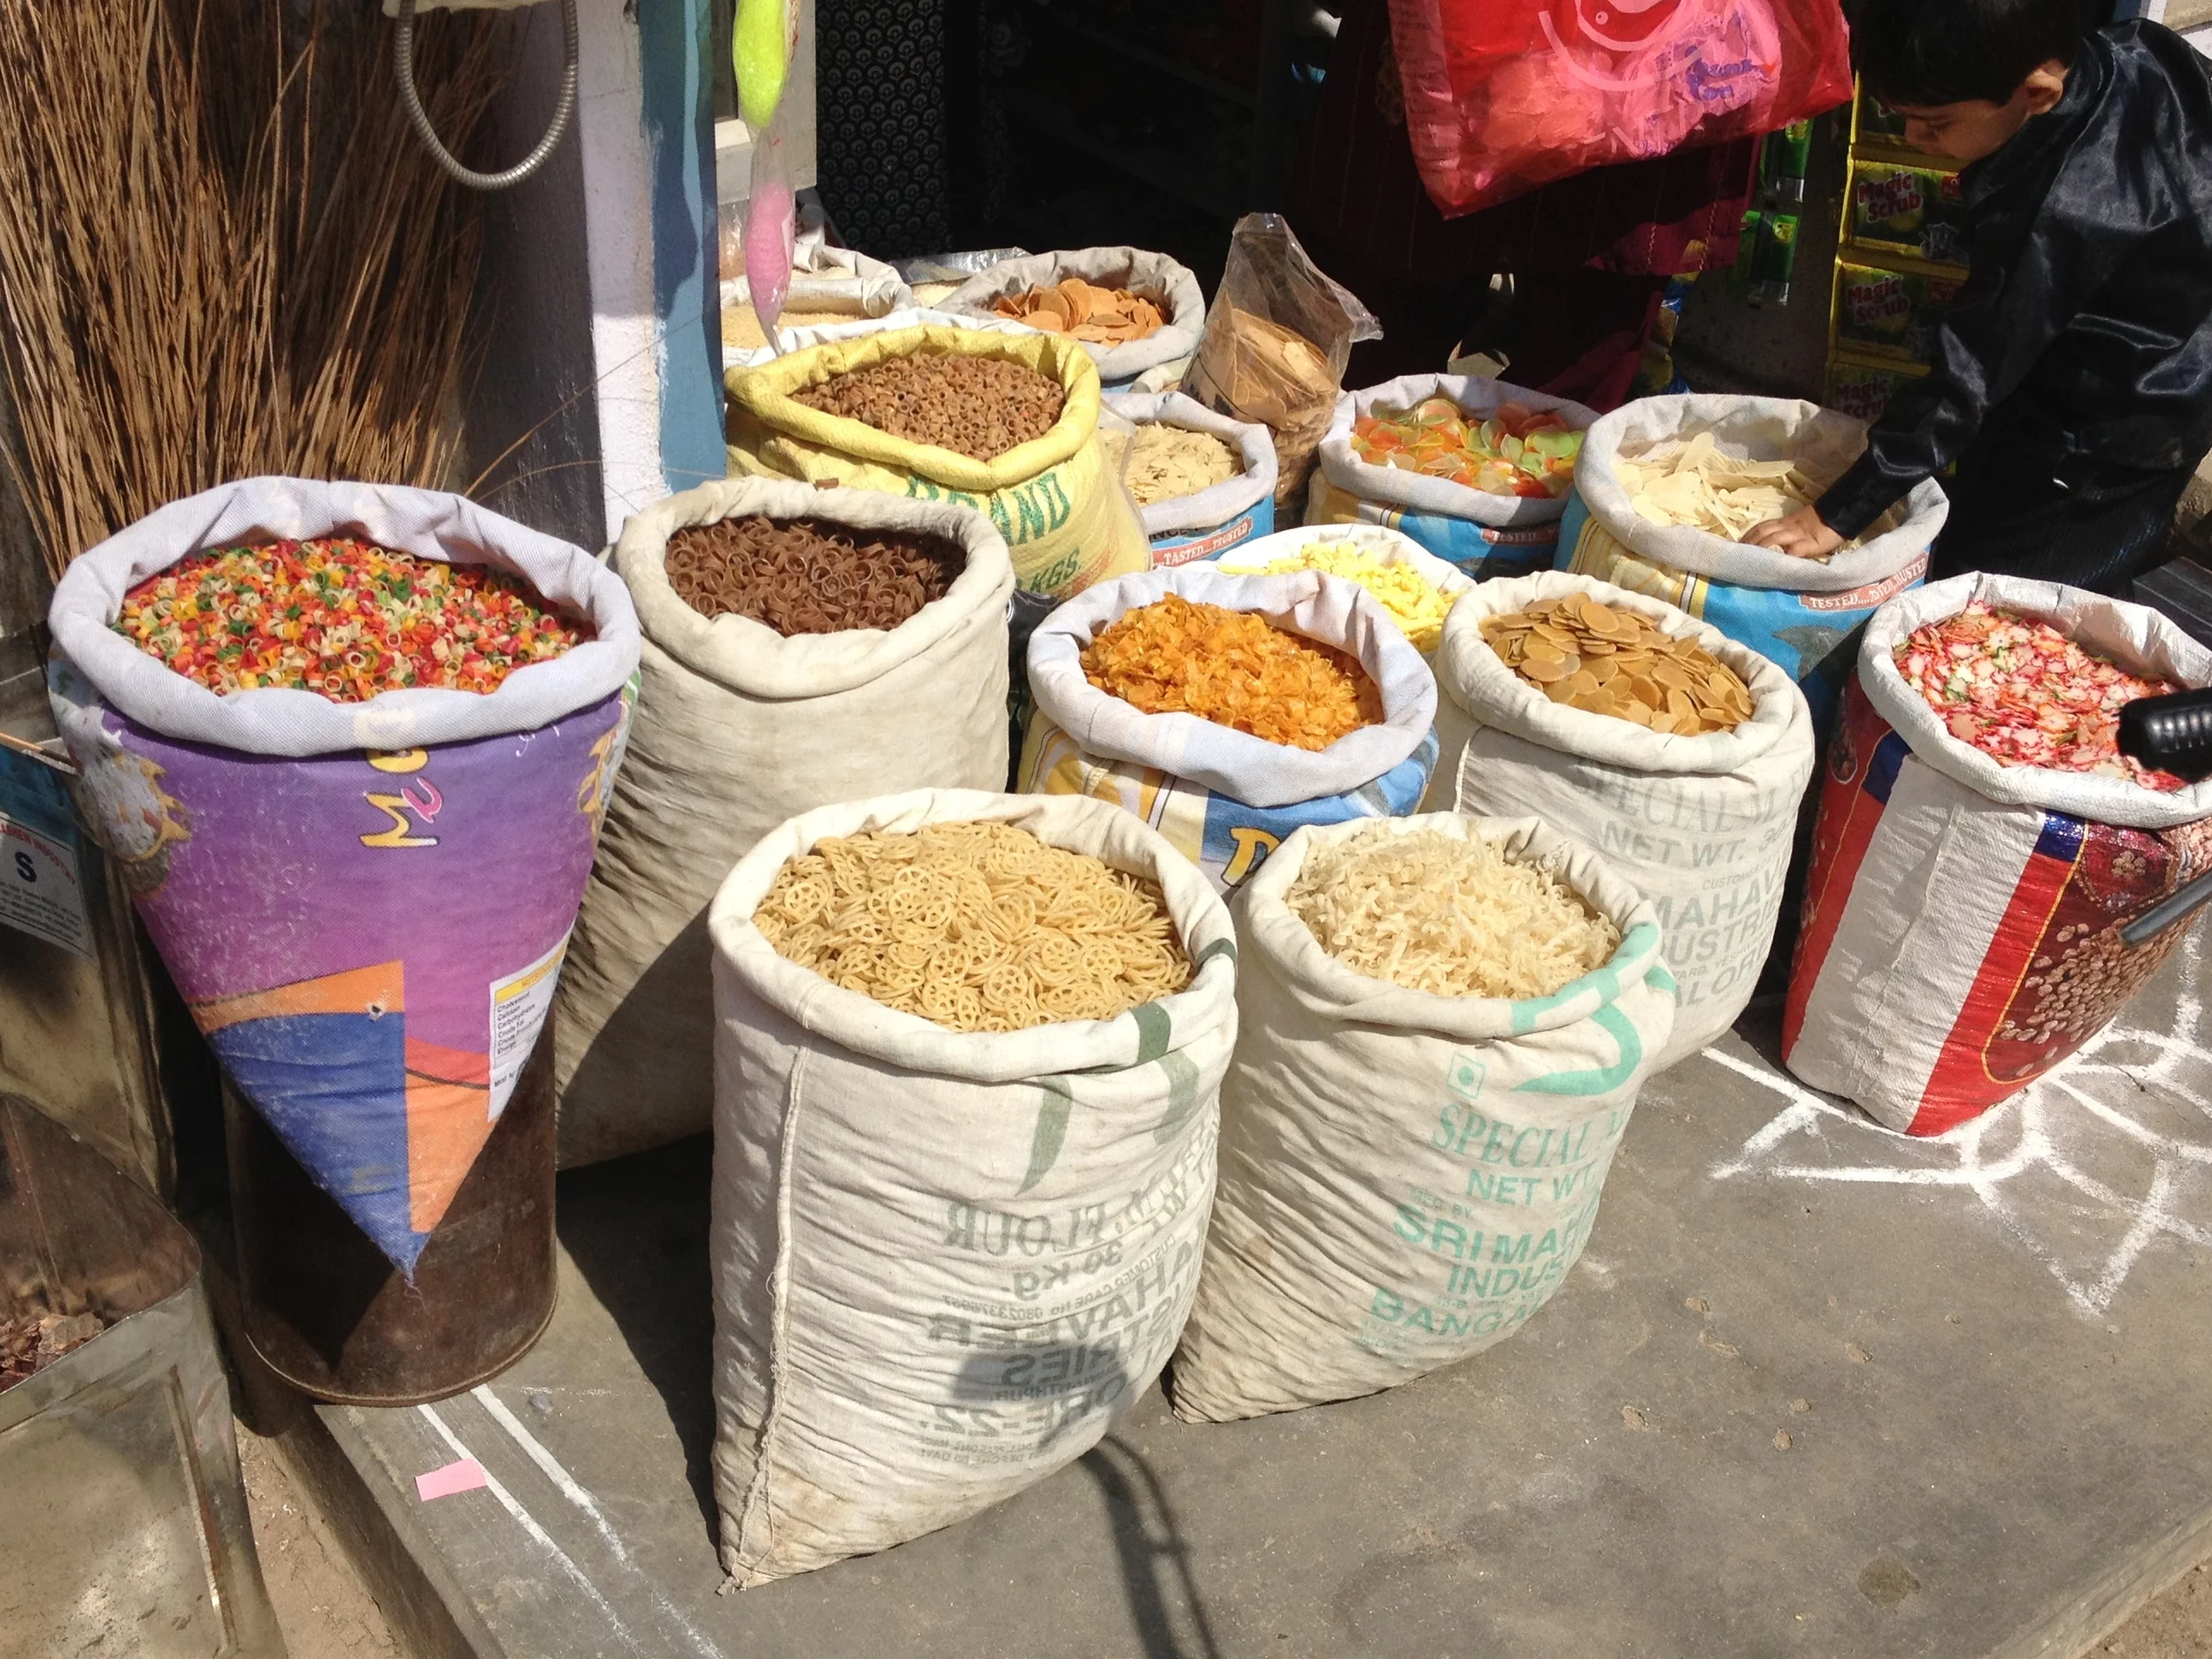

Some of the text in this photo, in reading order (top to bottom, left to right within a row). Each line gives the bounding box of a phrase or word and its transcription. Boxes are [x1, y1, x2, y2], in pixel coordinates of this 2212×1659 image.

[1859, 172, 1914, 204] Magic
[1868, 192, 1923, 222] Scrub
[1847, 277, 1901, 304] Magic
[1855, 297, 1909, 324] Scrub
[1602, 819, 1683, 864] NET
[14, 851, 37, 883] S
[1432, 1103, 1593, 1168] SPECIAL
[1466, 1169, 1543, 1206] NET
[1394, 1203, 1483, 1262] SRI
